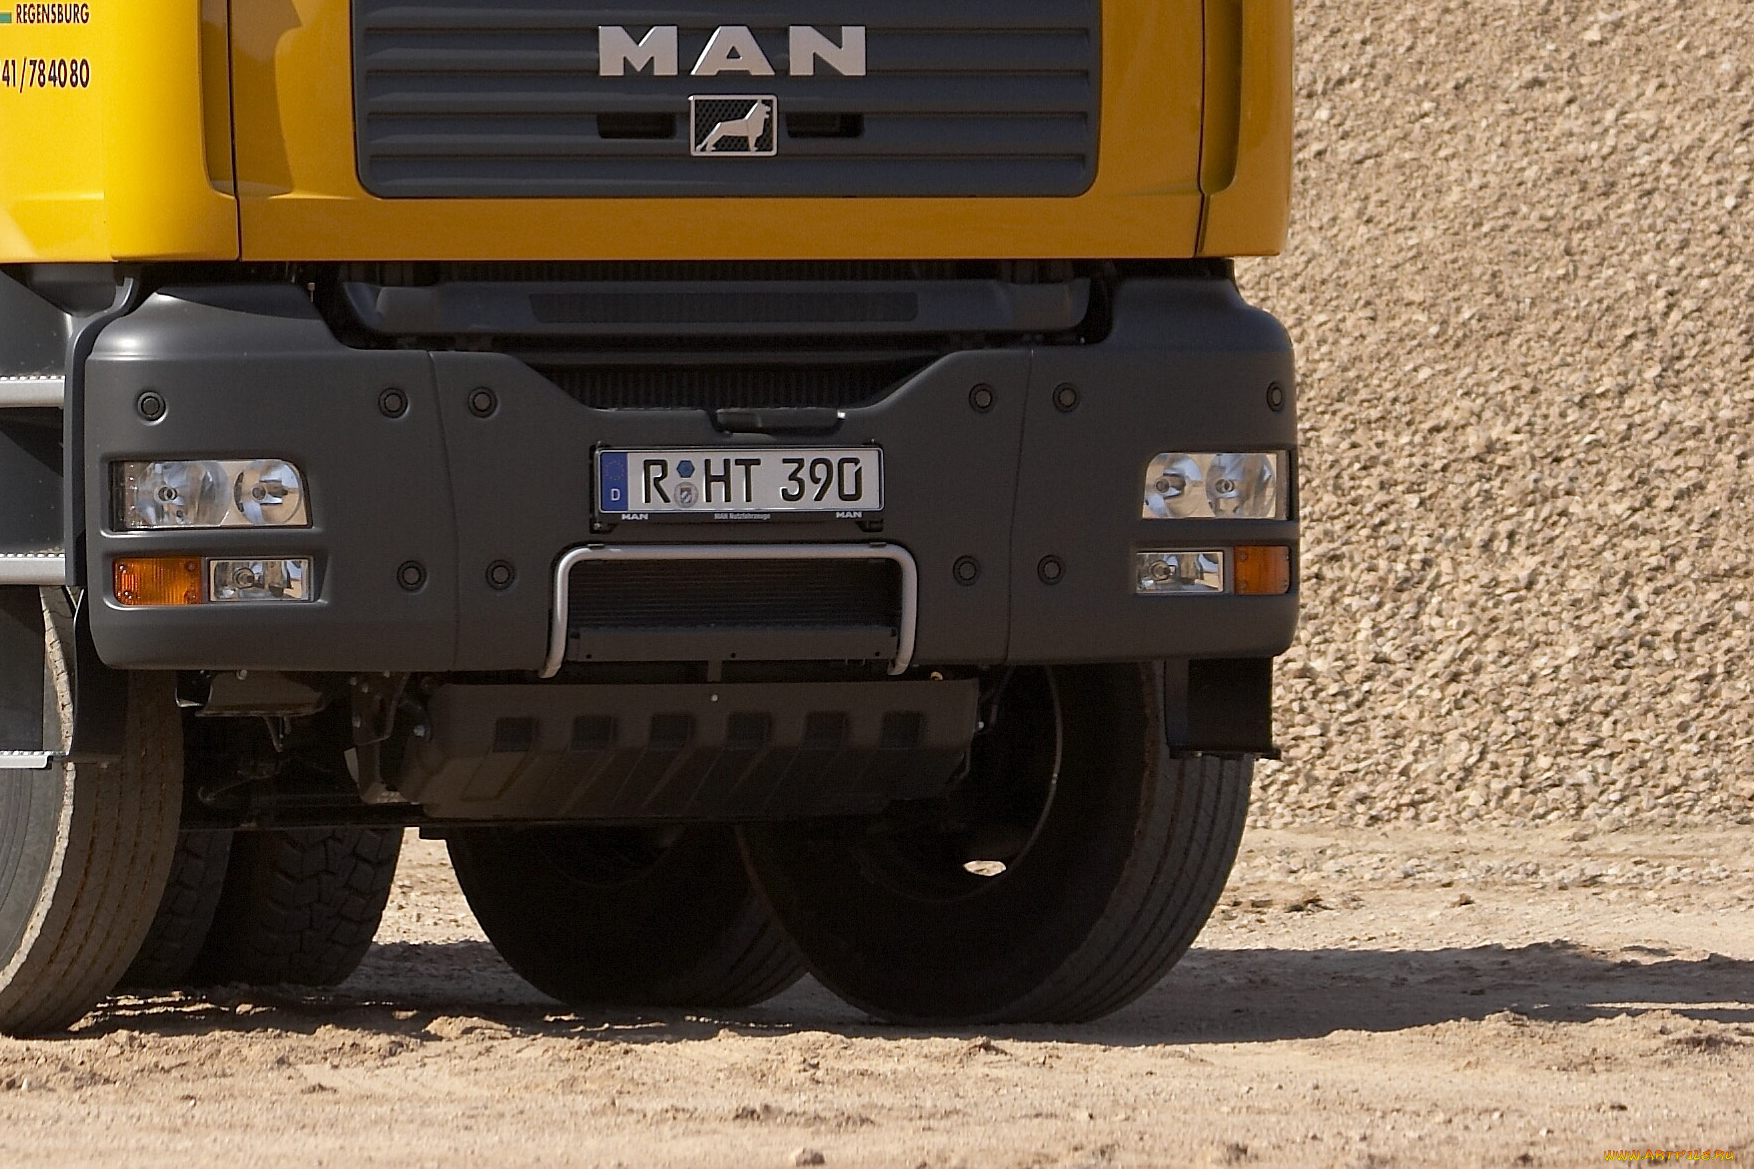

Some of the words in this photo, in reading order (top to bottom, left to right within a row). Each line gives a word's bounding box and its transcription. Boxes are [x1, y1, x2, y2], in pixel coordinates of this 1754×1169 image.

[16, 3, 89, 24] REGENSBURG
[598, 25, 867, 76] MAN
[611, 488, 621, 501] D
[642, 459, 670, 504] R
[704, 458, 761, 503] HT
[780, 457, 863, 502] 390
